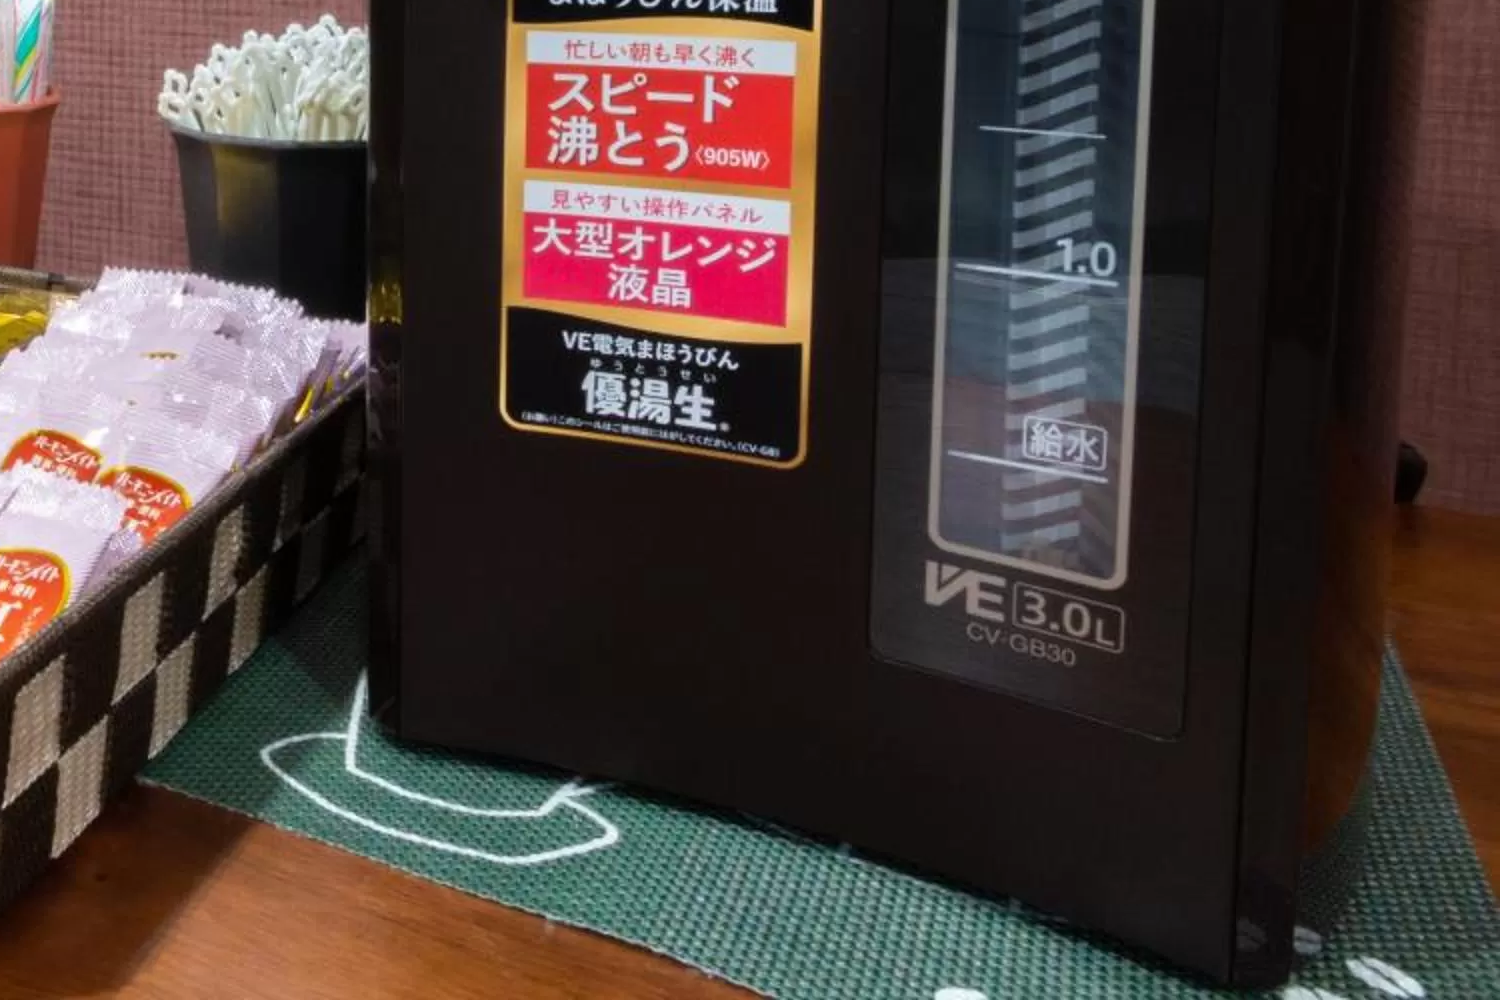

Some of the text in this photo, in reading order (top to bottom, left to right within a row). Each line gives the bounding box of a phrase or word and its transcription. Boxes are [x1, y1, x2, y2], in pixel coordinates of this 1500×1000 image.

[564, 39, 757, 68] 忙しい朝も早く沸く
[548, 72, 740, 123] スピード
[551, 189, 764, 224] 見やすい操作パネル
[533, 218, 777, 273] 大型オレンジ
[1056, 239, 1117, 278] 1.0
[608, 263, 692, 309] 液晶
[562, 330, 740, 371] VE電気まほうびん
[581, 369, 718, 432] 優湯生
[1030, 422, 1100, 463] 給水
[925, 560, 1116, 647] VE 3.0L
[966, 622, 1077, 667] CV-GB30
